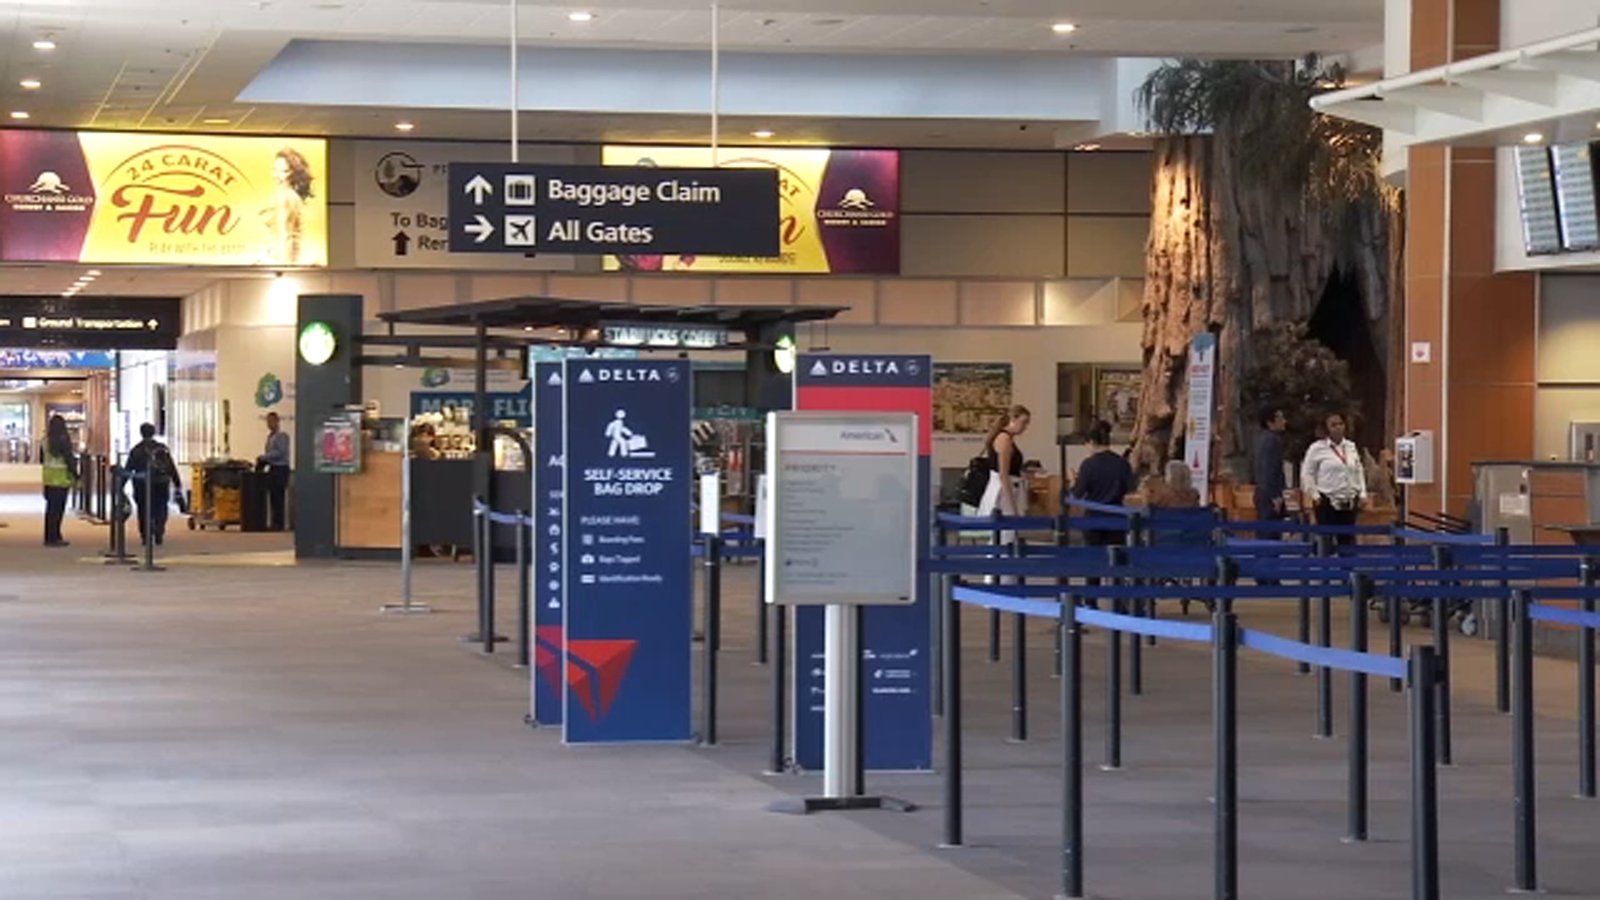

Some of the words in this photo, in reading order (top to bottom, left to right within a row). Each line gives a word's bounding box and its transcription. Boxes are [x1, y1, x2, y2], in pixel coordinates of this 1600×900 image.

[127, 158, 155, 181] 24
[161, 153, 238, 187] CARAT
[548, 179, 649, 206] Baggage
[656, 179, 720, 202] Claim
[111, 183, 241, 243] Fun
[390, 212, 411, 229] To
[548, 221, 580, 243] All
[586, 221, 653, 244] Gates
[38, 317, 73, 329] Ground
[75, 318, 144, 330] Transportation
[604, 327, 679, 346] STARBUCKS
[680, 328, 728, 347] COFFEE
[831, 360, 899, 374] DELTA
[598, 368, 661, 382] DELTA
[840, 430, 884, 441] American
[584, 468, 673, 481] SELF-SERVICE
[594, 482, 623, 496] BAG
[624, 482, 664, 496] DROP
[580, 515, 611, 526] PLEASE
